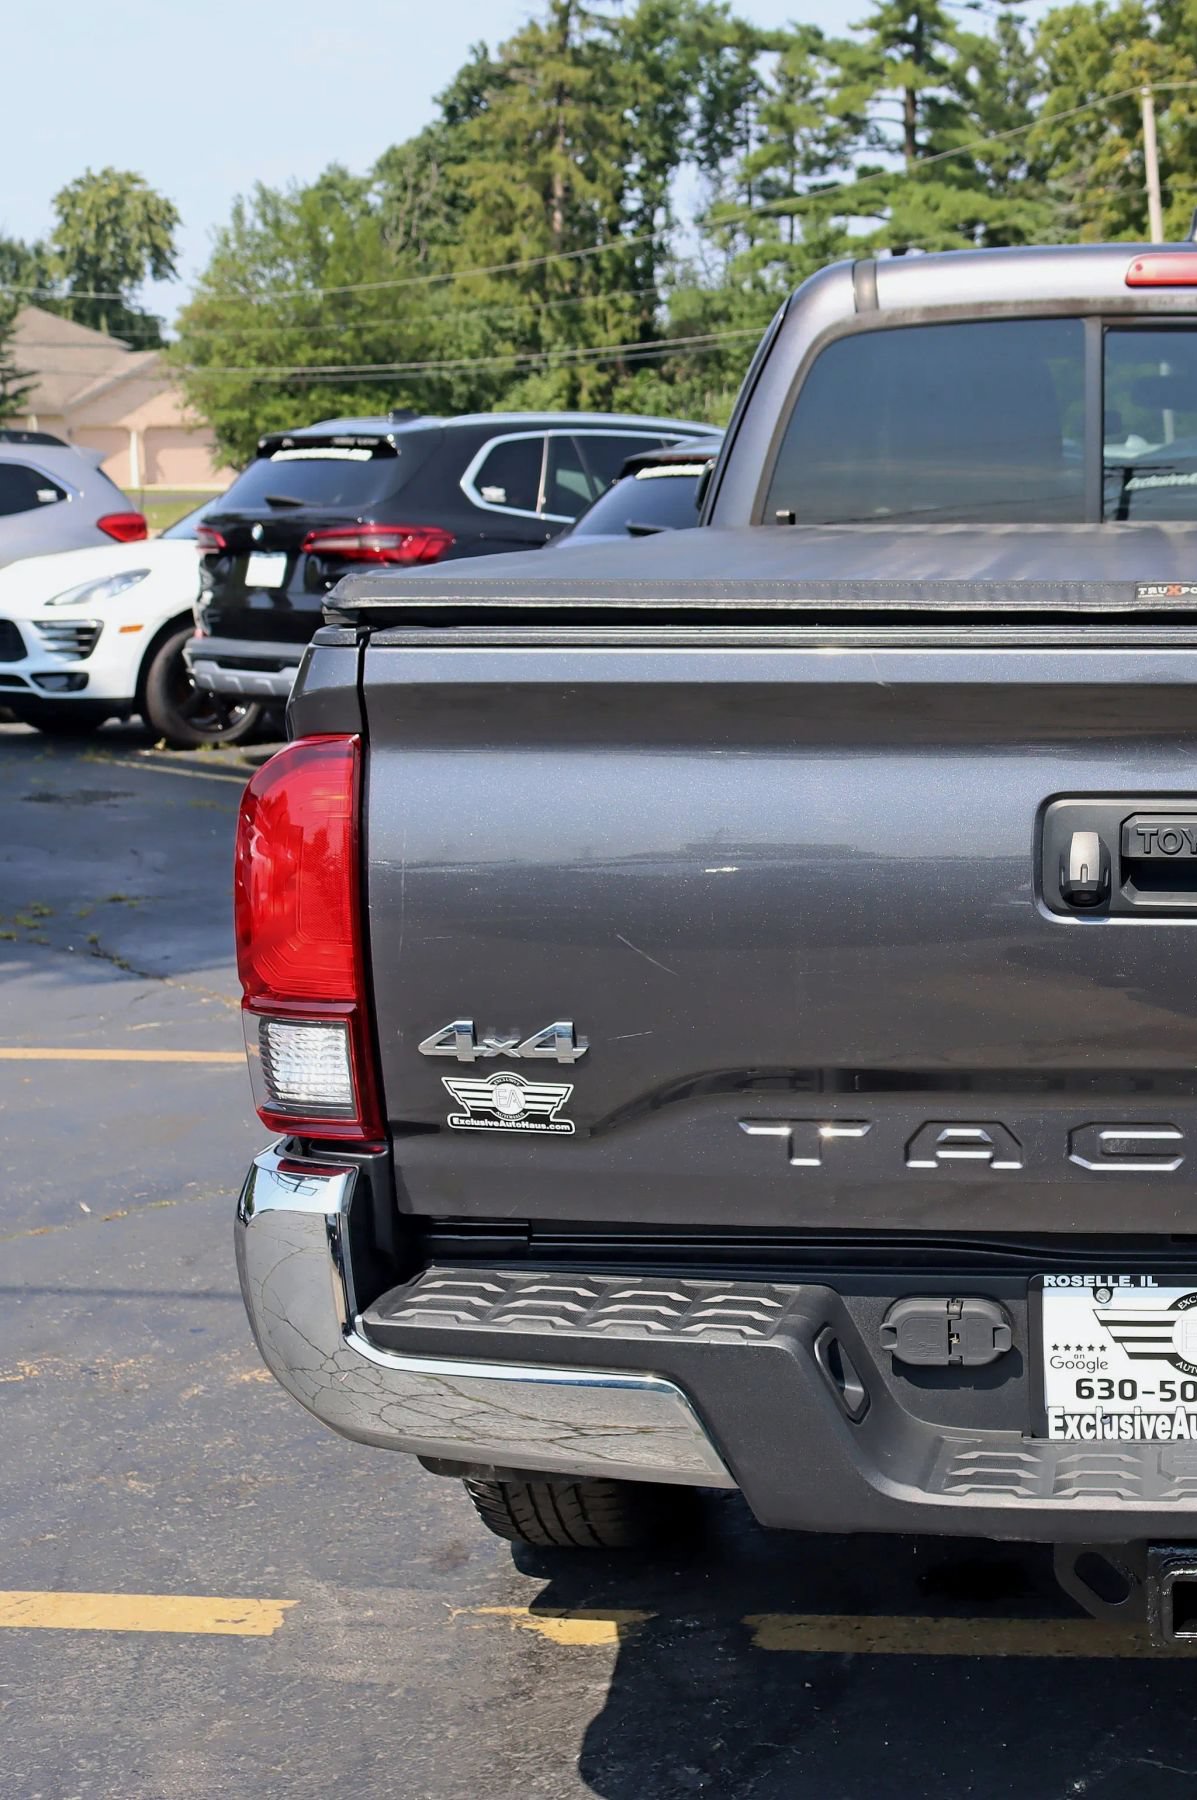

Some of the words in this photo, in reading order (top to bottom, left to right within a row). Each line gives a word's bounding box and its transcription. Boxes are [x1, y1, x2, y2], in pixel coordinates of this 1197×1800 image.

[418, 1020, 589, 1063] 4x4
[1043, 1275, 1134, 1288] ROSELLE,
[1140, 1276, 1158, 1287] IL
[1050, 1355, 1109, 1373] Google
